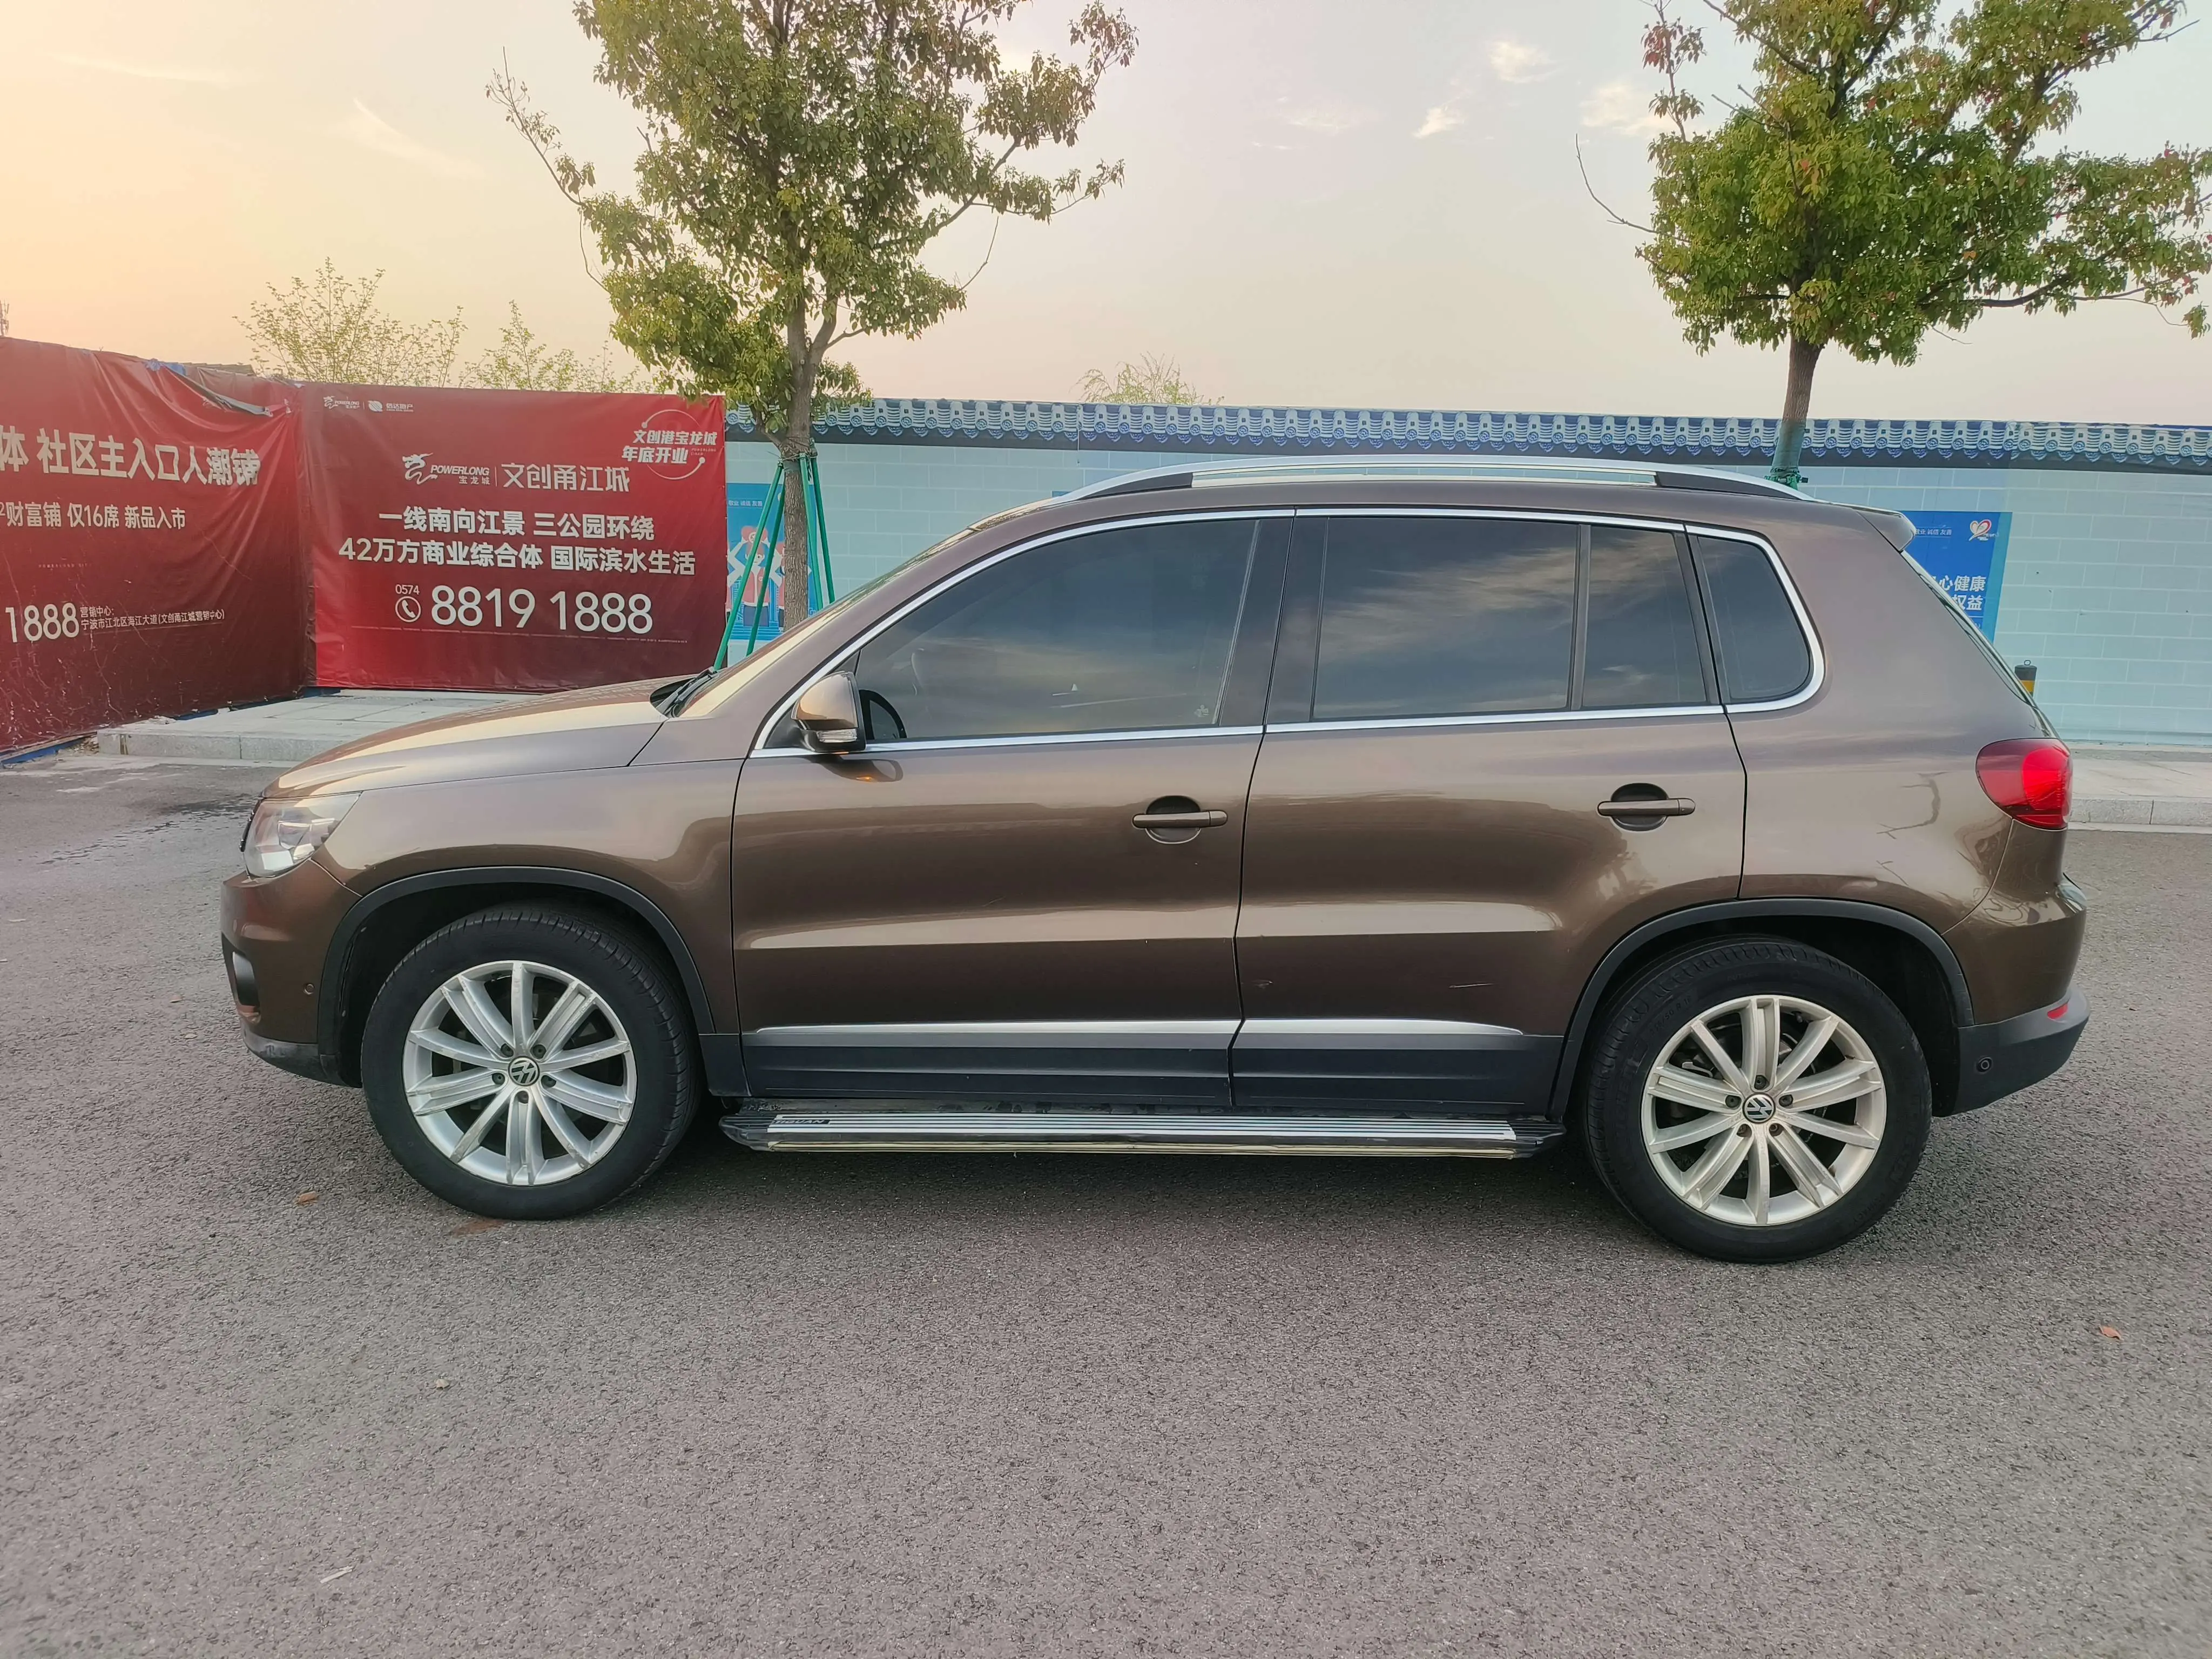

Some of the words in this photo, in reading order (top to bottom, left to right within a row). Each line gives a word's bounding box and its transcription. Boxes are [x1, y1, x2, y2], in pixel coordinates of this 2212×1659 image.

[632, 429, 718, 446] 文创港宝龙城
[36, 427, 260, 485] 社区主入口人潮铺
[622, 446, 689, 464] 年底开业
[430, 464, 490, 476] POWERLONG
[458, 476, 490, 485] 宝龙城
[501, 462, 630, 492] 文创甬江城
[67, 503, 119, 528] 仅16席
[124, 504, 186, 530] 新品入市
[379, 505, 525, 537] 一线南向江景
[533, 511, 655, 541] 三公园环绕
[339, 537, 543, 570] 42万方商业综合体
[551, 545, 696, 576] 国际滨水生活
[395, 584, 420, 595] 0574
[5, 603, 79, 643] 1888
[431, 585, 536, 629] 8819
[550, 591, 653, 634] 1888
